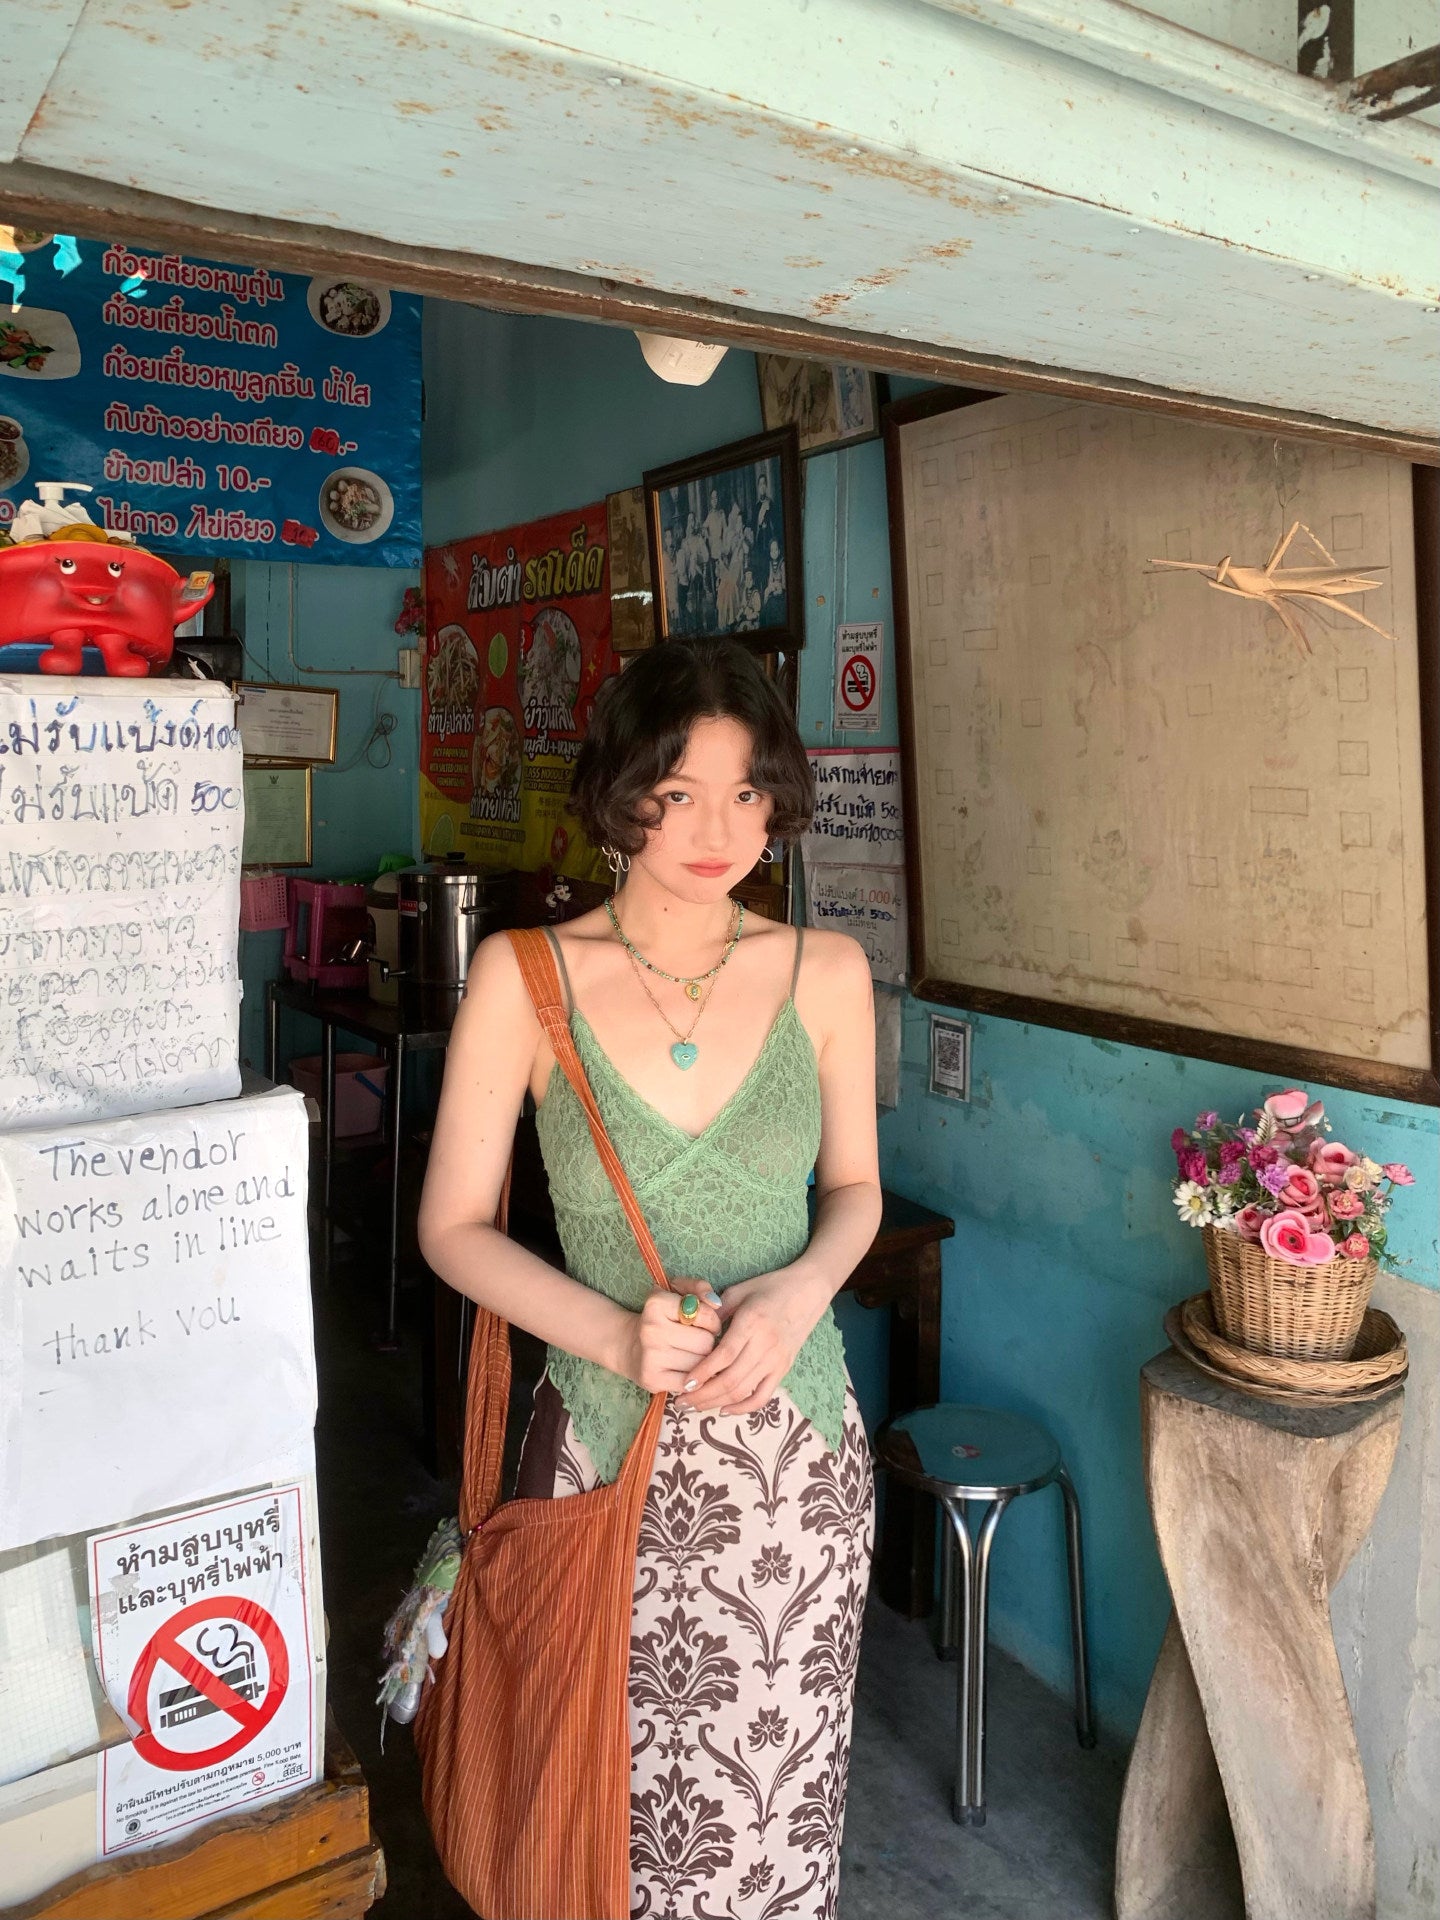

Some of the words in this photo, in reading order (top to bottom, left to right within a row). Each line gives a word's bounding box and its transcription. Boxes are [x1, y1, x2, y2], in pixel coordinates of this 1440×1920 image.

[103, 292, 278, 347] ก๋วยเตี๋ยวน้ำตก
[104, 344, 315, 403] ก๋วยเตี๋ยวหมูลูกชิ้น
[323, 365, 370, 406] น้ำใส
[104, 402, 303, 449] กับข้าวอย่างเดียว
[104, 448, 205, 490] ข้าวเปล่า
[216, 464, 272, 492] 10.-
[96, 497, 178, 536] ไข่ดาว
[191, 781, 241, 815] 500
[859, 889, 890, 905] 1,000
[39, 1141, 113, 1181] The
[119, 1130, 245, 1175] vendor
[14, 1197, 123, 1238] works
[142, 1184, 228, 1222] alone
[235, 1166, 295, 1206] and
[19, 1240, 150, 1288] waits
[174, 1231, 206, 1263] in
[220, 1216, 282, 1251] line
[42, 1310, 156, 1364] thank
[117, 1499, 280, 1575] ห้ามสูบบุหรี่
[118, 1546, 283, 1614] และบุหรี่ไฟฟ้า
[257, 1748, 281, 1763] 5,000
[284, 1741, 302, 1754] บาท
